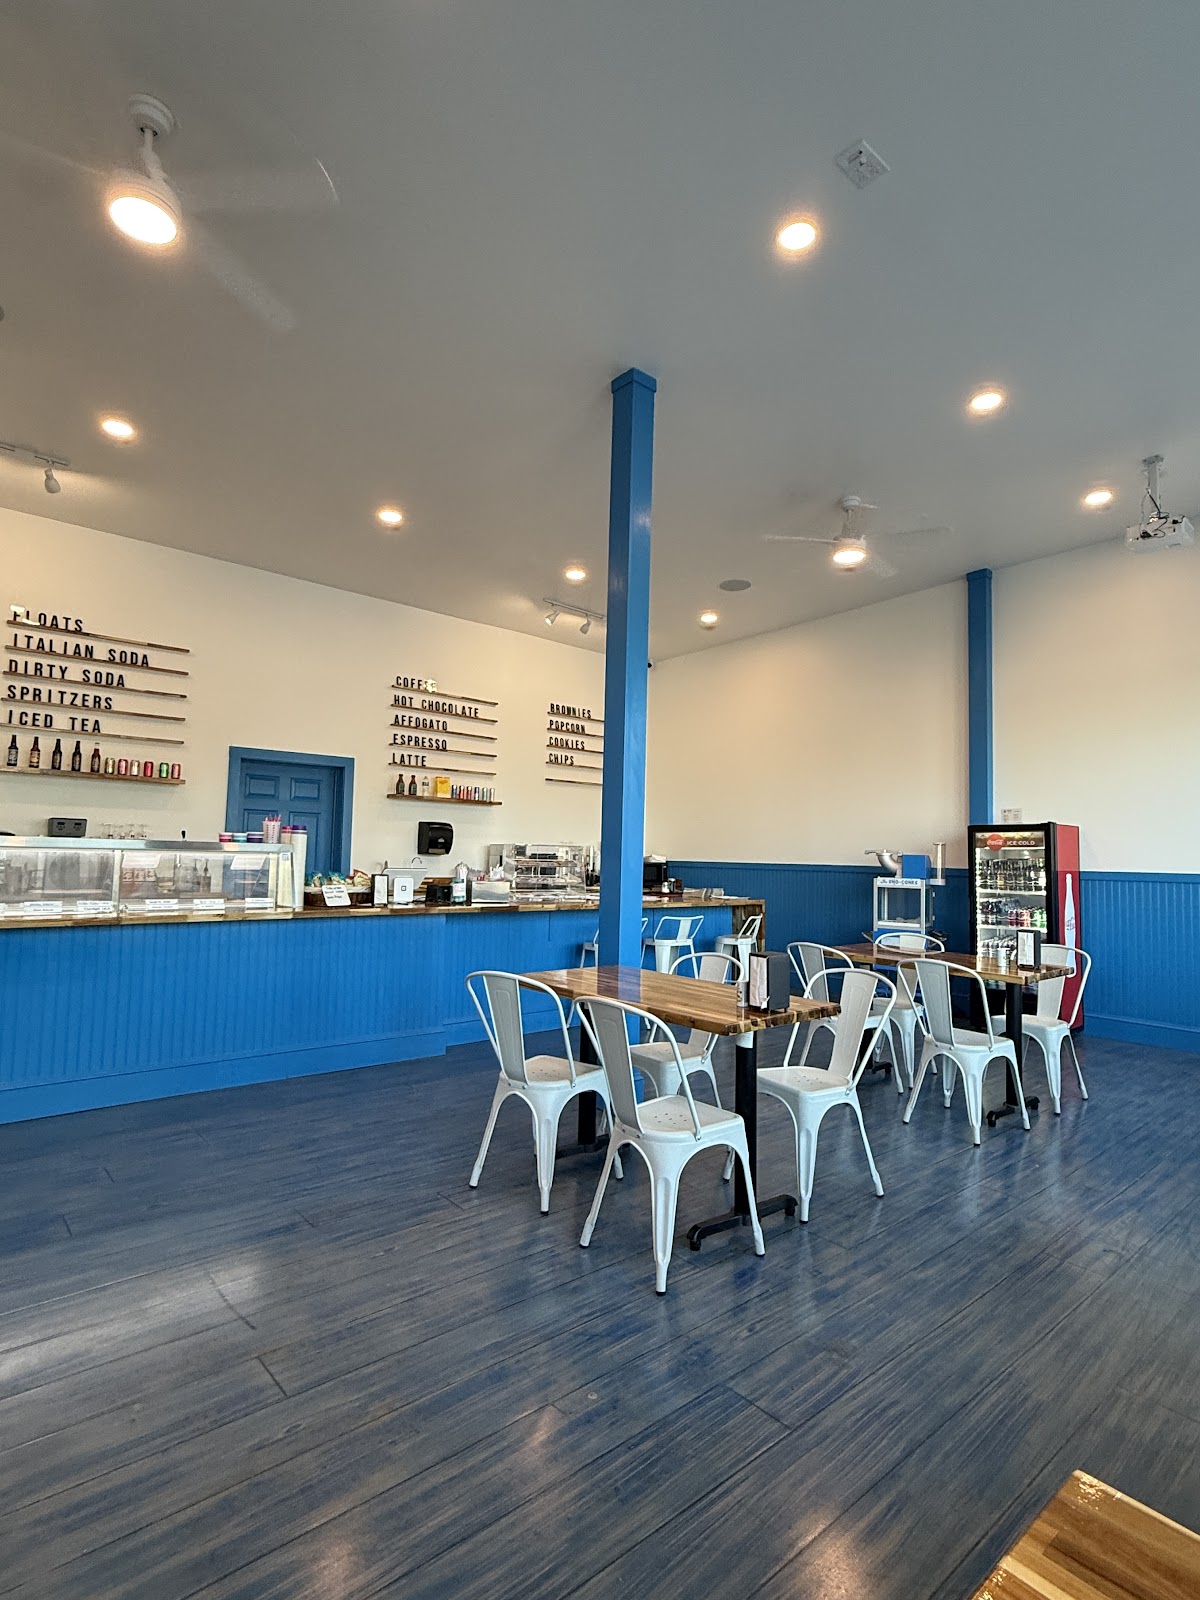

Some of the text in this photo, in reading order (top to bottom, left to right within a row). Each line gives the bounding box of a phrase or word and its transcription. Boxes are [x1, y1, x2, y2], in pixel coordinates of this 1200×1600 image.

[13, 633, 149, 667] ITALIAN SODA
[9, 659, 125, 687] DIRTY SODA
[7, 684, 113, 710] SPRITZERS
[394, 694, 479, 718] HOT CHOCOLATE
[550, 703, 592, 719] BROWNIES
[8, 710, 101, 733] ICED TEA
[394, 714, 448, 731] AFFOGATO
[549, 720, 586, 734] POPCORN
[393, 733, 447, 750] ESPRESSO
[549, 736, 585, 750] COOKIES
[392, 752, 427, 767] LATTE
[548, 753, 575, 766] CHIPS
